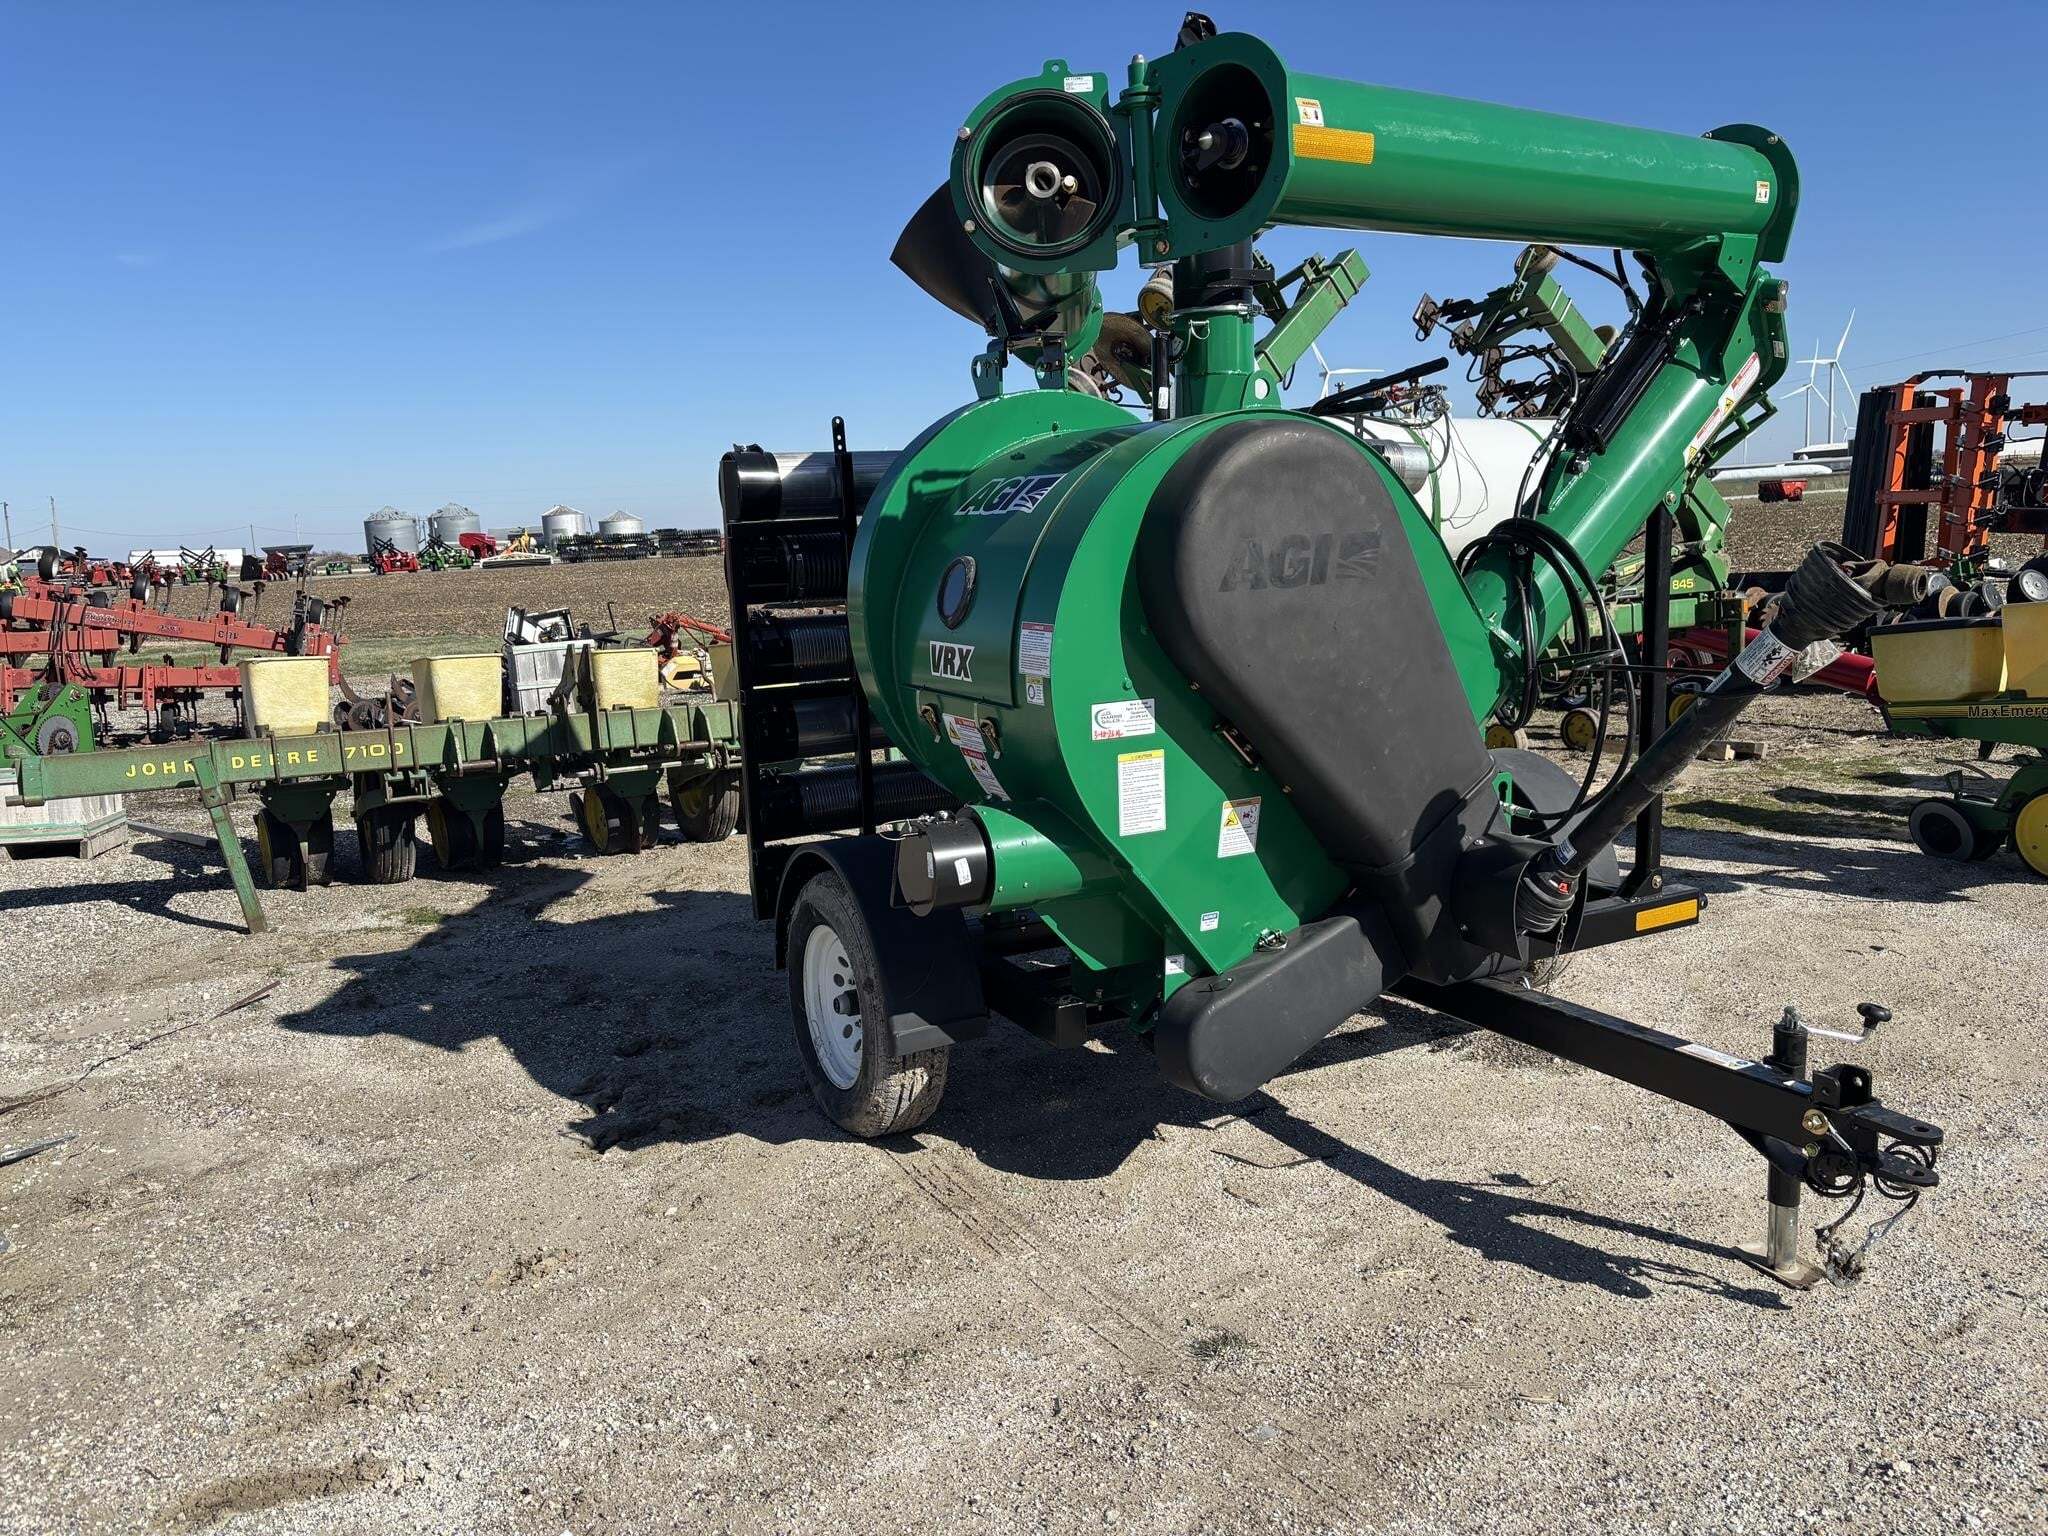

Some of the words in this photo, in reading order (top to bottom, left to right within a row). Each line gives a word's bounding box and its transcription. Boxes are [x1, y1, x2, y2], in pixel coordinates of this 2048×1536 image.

[956, 476, 1036, 514] AGI
[1218, 533, 1333, 592] AGI
[1672, 578, 1694, 590] 845
[931, 643, 973, 681] VRX
[344, 743, 404, 759] 7100
